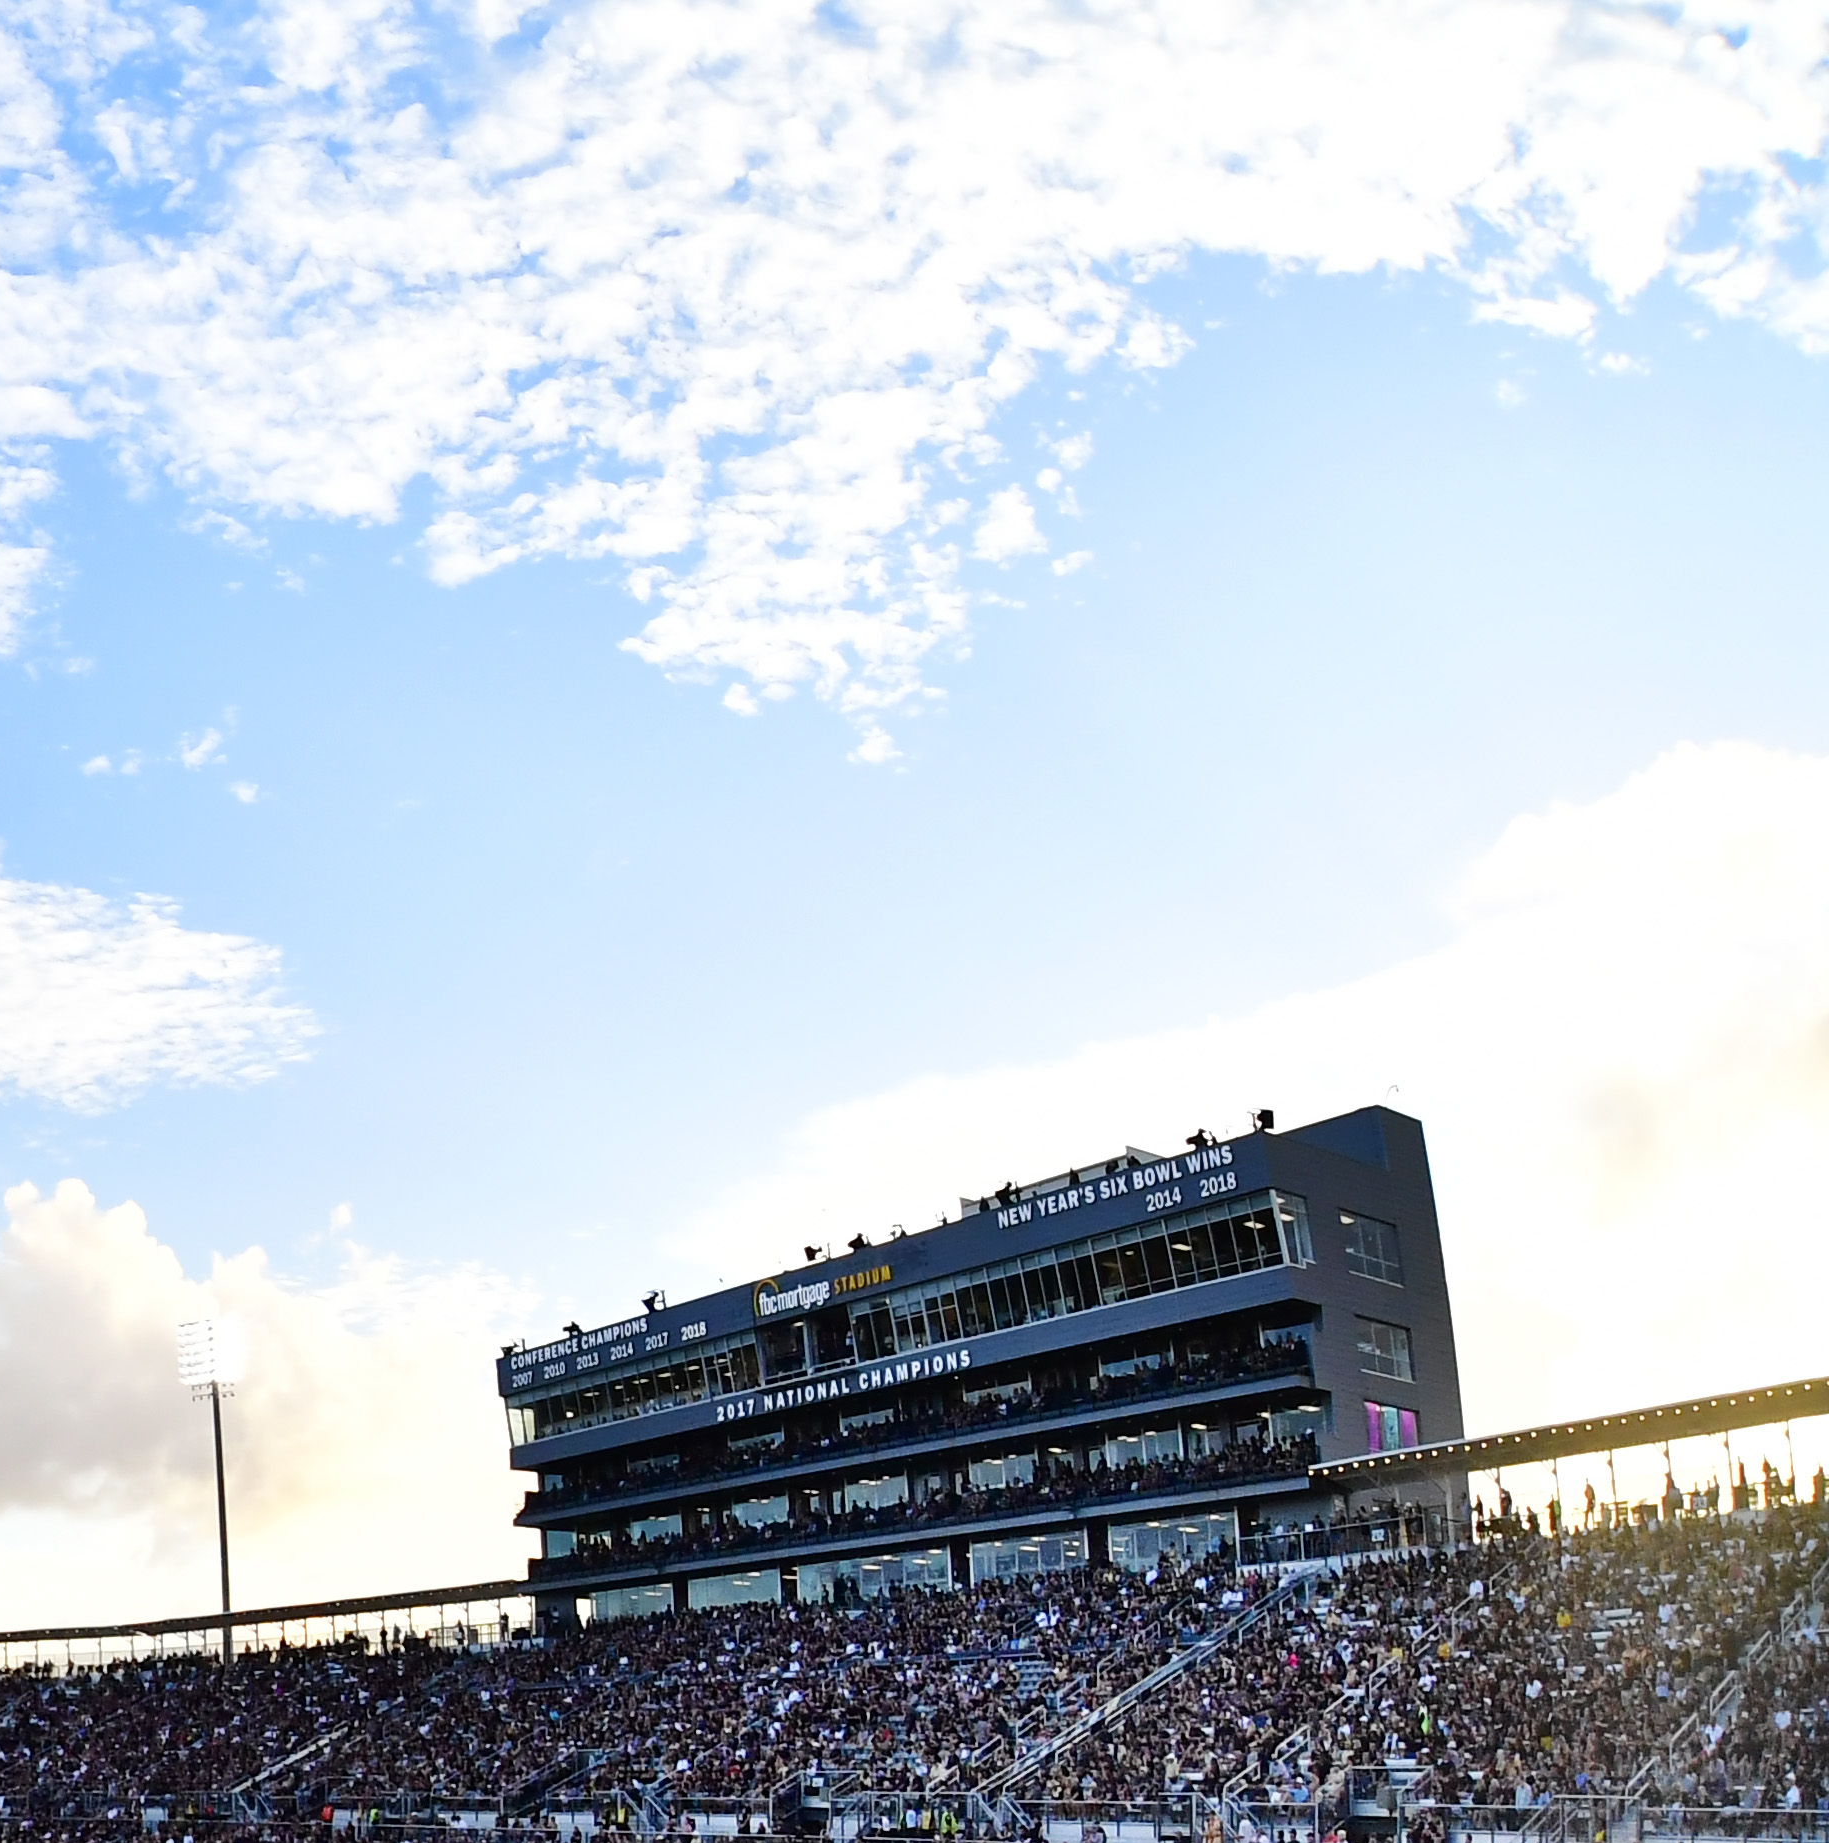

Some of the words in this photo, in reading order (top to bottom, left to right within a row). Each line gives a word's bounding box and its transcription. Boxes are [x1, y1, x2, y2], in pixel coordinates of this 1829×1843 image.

[997, 1204, 1032, 1229] NEW
[1037, 1188, 1096, 1218] YEAR'S
[1100, 1175, 1128, 1200] SIX
[1132, 1160, 1182, 1190] BOWL
[1185, 1145, 1234, 1175] WINS
[1145, 1187, 1182, 1212] 2014
[1199, 1172, 1237, 1198] 2018
[834, 1265, 891, 1294] STADIUM
[511, 1338, 579, 1370] CONFERENCE
[581, 1317, 648, 1349] CHAMPIONS
[512, 1371, 533, 1388] 2007
[543, 1362, 566, 1379] 2010
[576, 1352, 599, 1370] 2013
[610, 1342, 634, 1360] 2014
[645, 1332, 669, 1351] 2017
[681, 1321, 707, 1341] 2018
[716, 1399, 755, 1421] 2017
[763, 1377, 850, 1411] NATIONAL
[859, 1349, 971, 1389] CHAMPIONS
